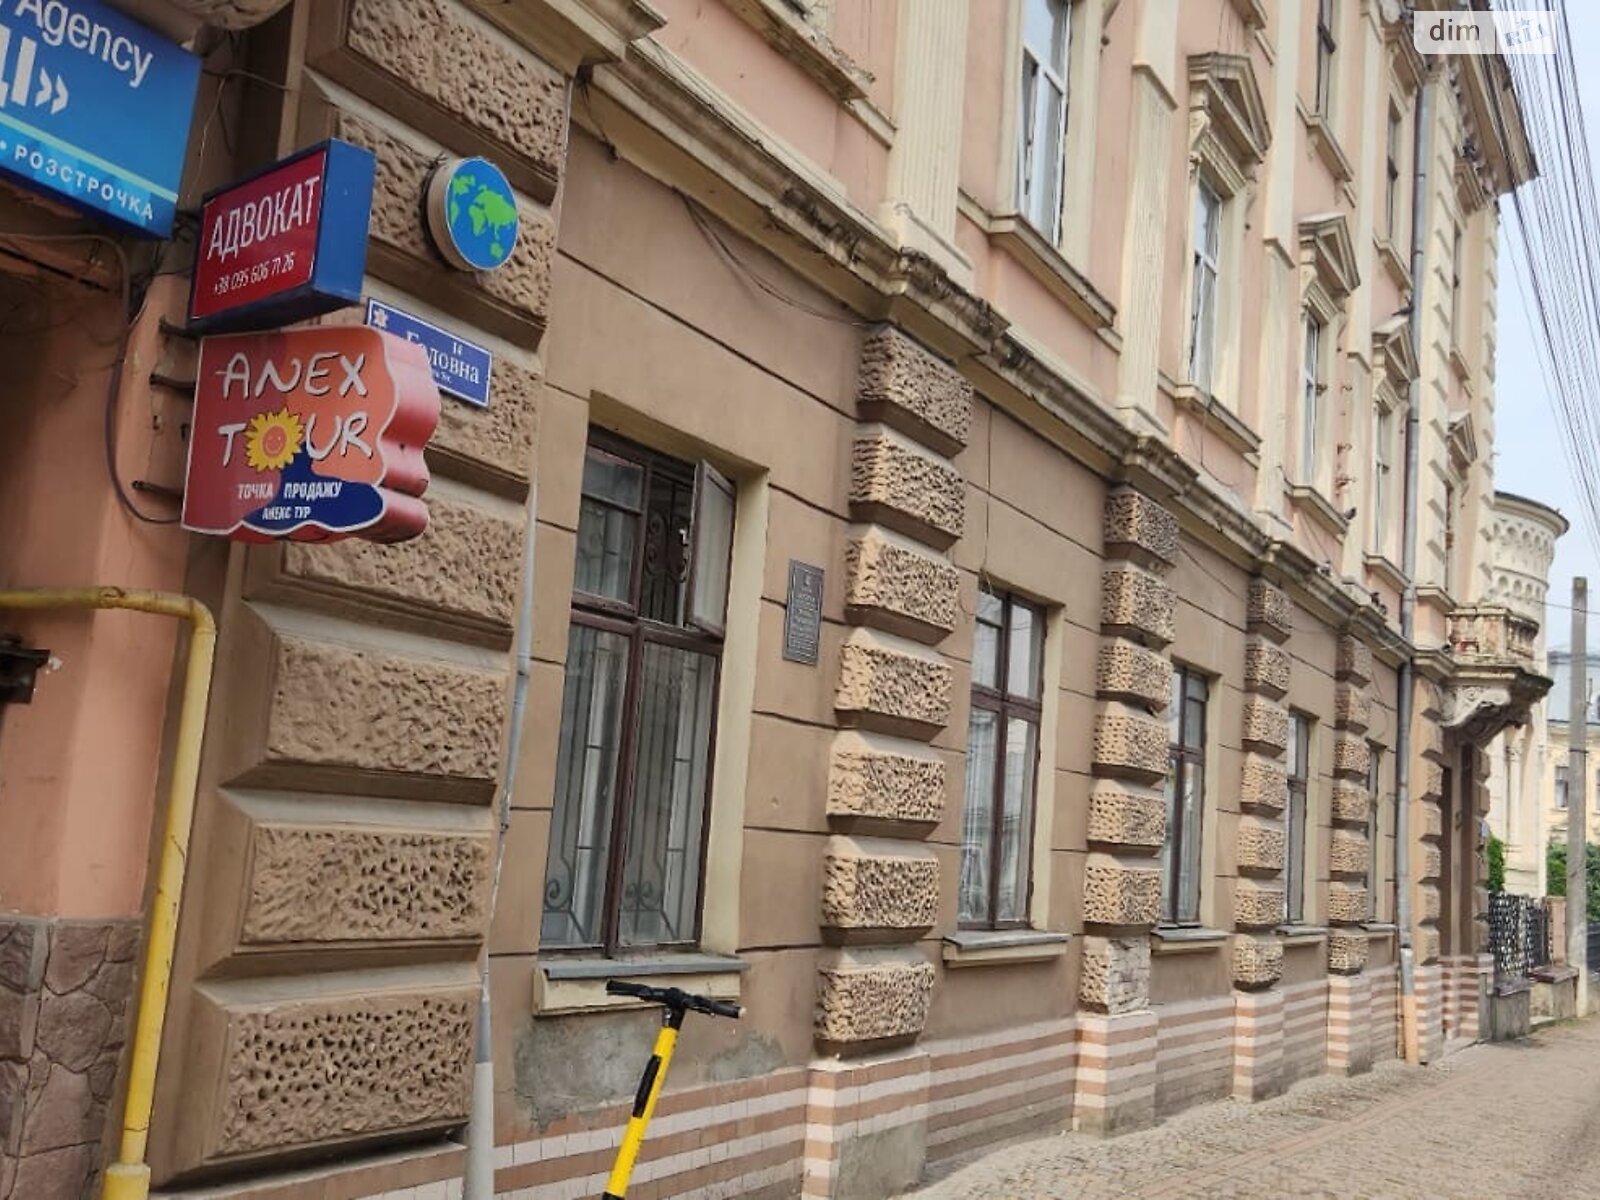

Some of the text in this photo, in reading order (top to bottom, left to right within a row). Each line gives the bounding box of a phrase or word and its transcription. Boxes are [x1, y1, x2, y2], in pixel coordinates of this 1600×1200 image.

[15, 0, 153, 88] Agency
[15, 144, 153, 220] РОЗСТРОЧКА
[207, 175, 320, 263] АДВОКАТ
[215, 351, 369, 400] ANEX
[237, 480, 343, 500] ТОЧКА ПРОДАЖУ
[262, 506, 312, 521] АНЕКС ТУР
